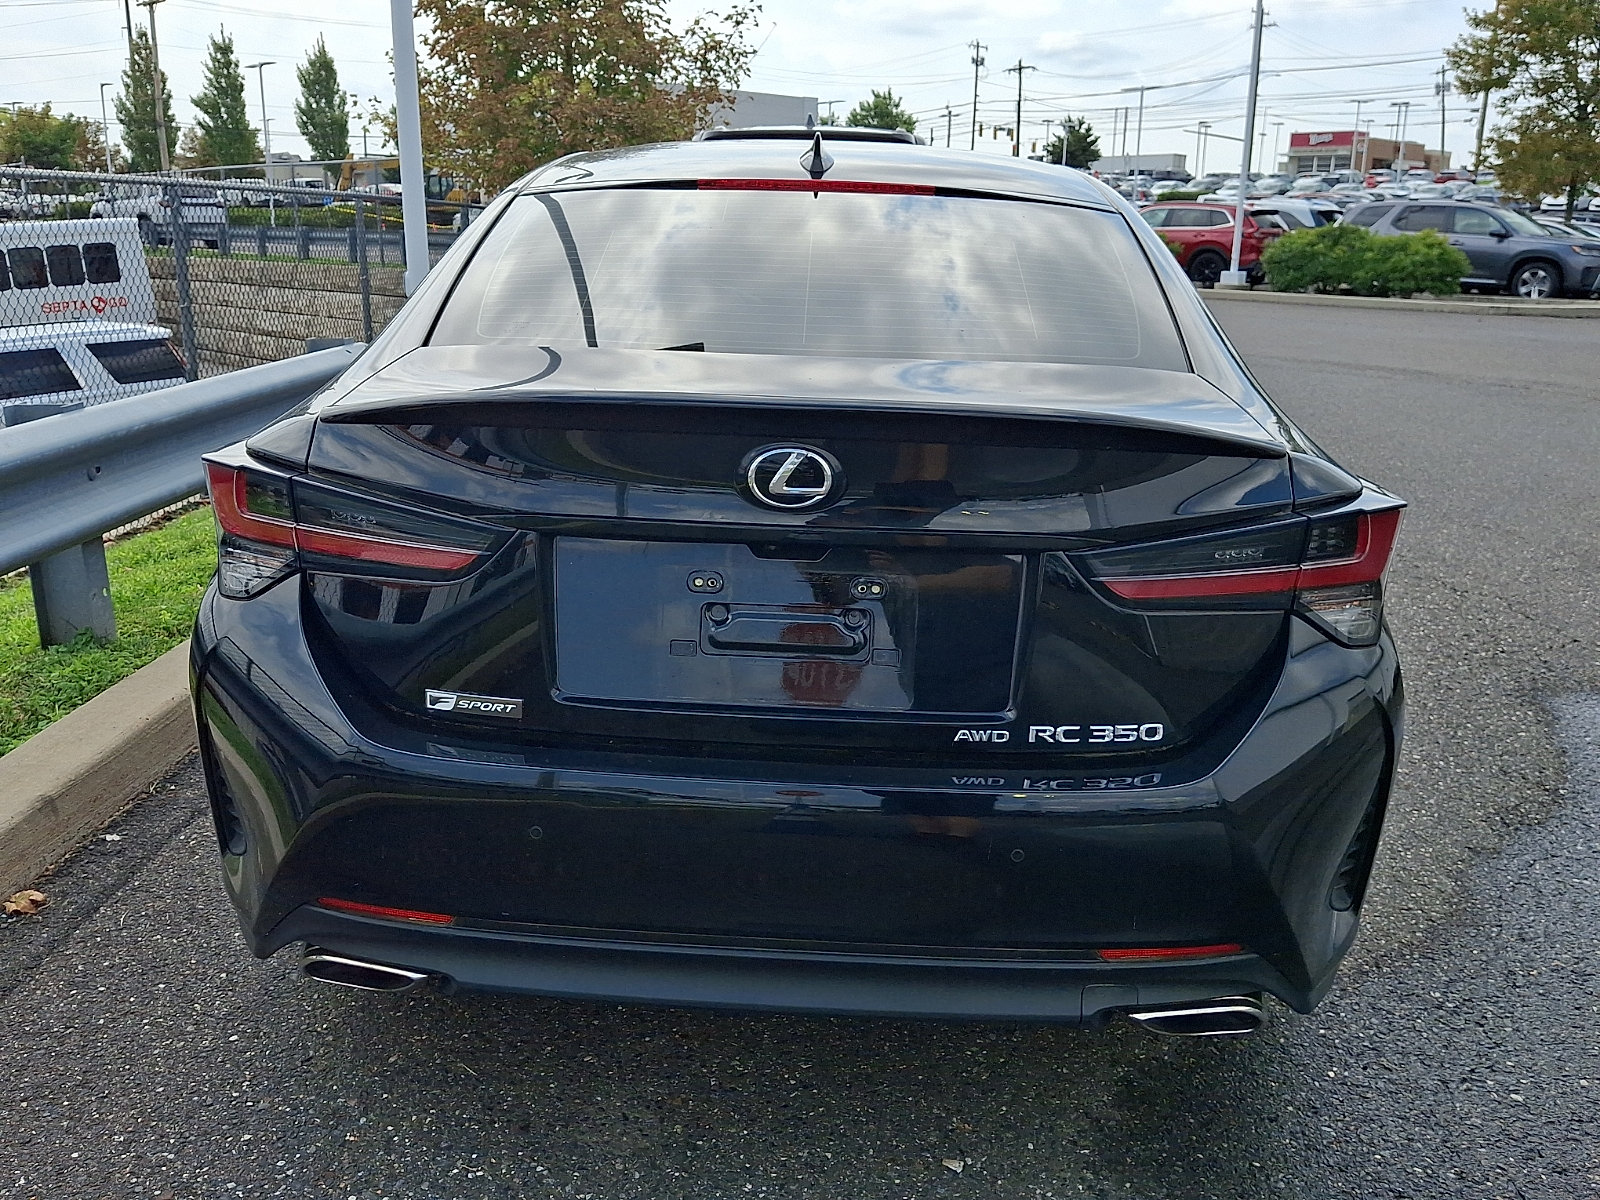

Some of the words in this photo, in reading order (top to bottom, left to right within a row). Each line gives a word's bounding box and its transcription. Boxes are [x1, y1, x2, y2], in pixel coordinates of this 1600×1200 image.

[42, 300, 89, 314] SEPTA
[456, 700, 517, 713] SPORT
[953, 729, 1010, 742] AWD
[1028, 725, 1081, 743] RC
[1088, 723, 1164, 743] 350
